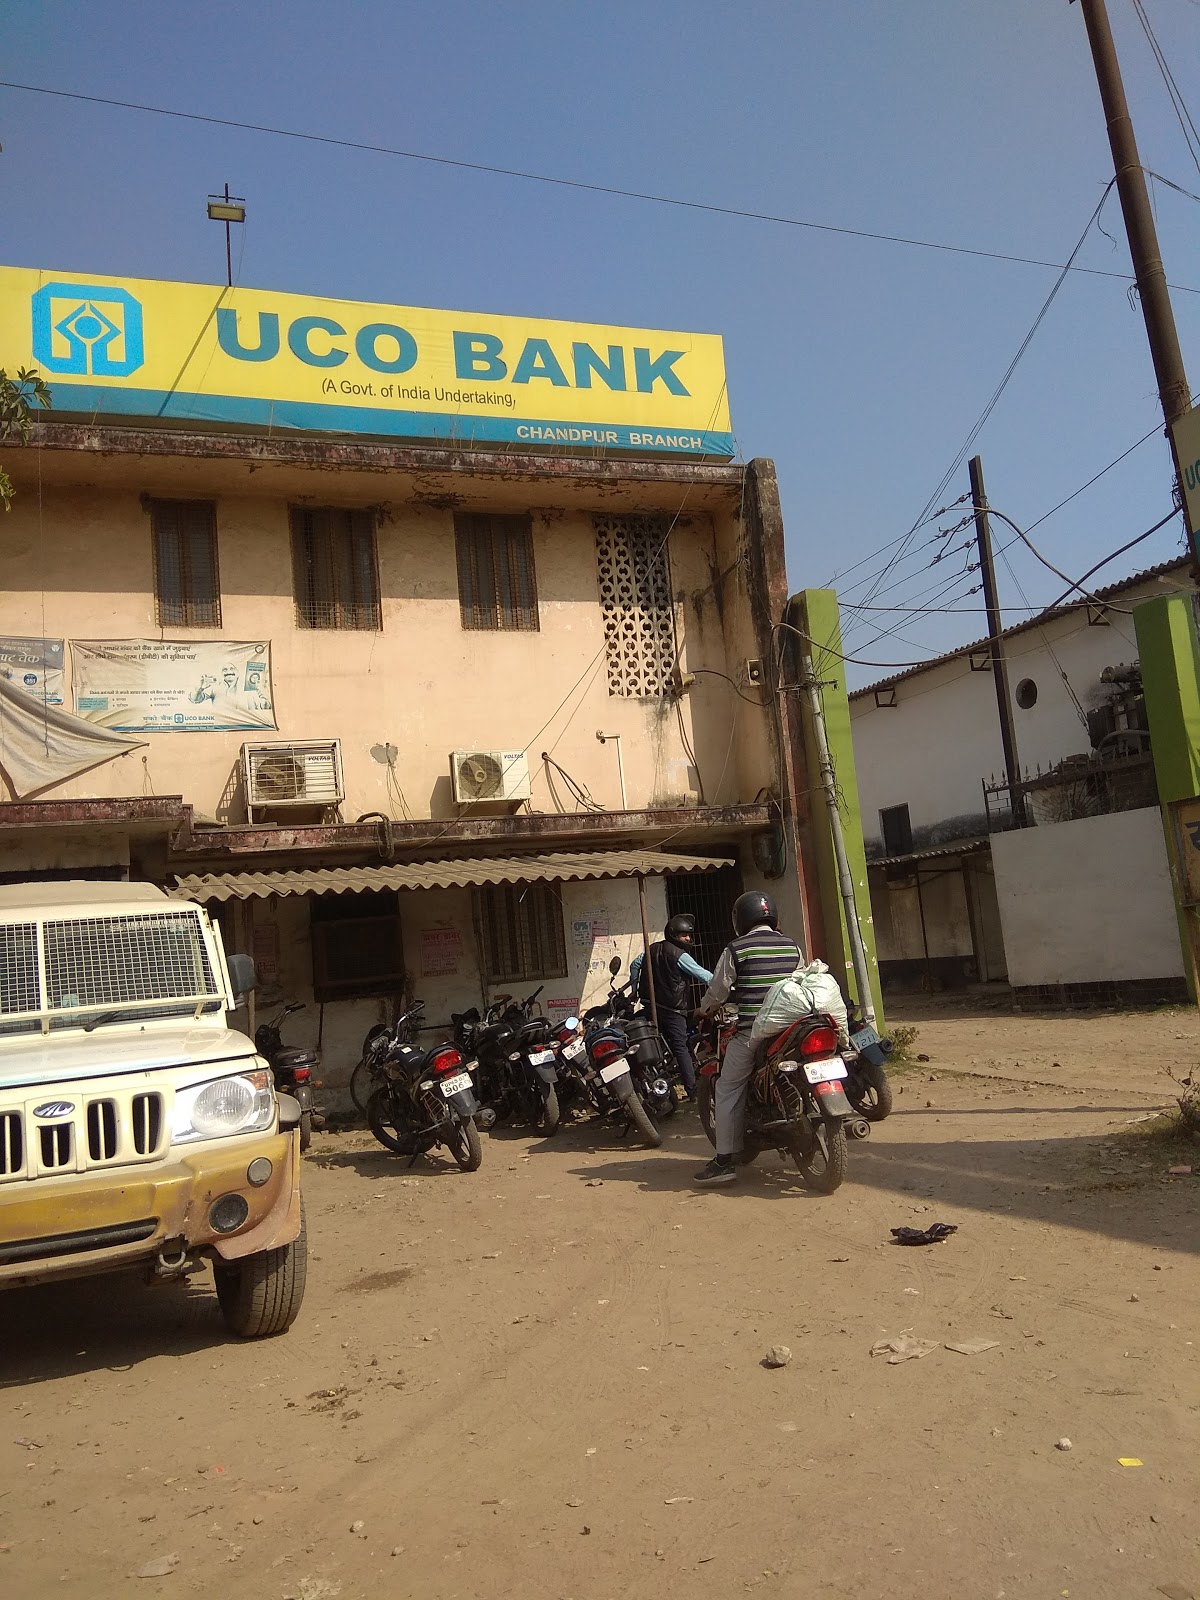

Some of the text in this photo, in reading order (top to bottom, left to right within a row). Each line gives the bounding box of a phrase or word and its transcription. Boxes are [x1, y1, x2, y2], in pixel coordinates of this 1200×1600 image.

[216, 309, 691, 395] UCO BANK
[321, 377, 337, 394] (A
[340, 379, 377, 397] Govt.
[380, 384, 394, 399] of
[398, 384, 431, 401] India
[516, 425, 702, 449] CHANDPUR BRANCH
